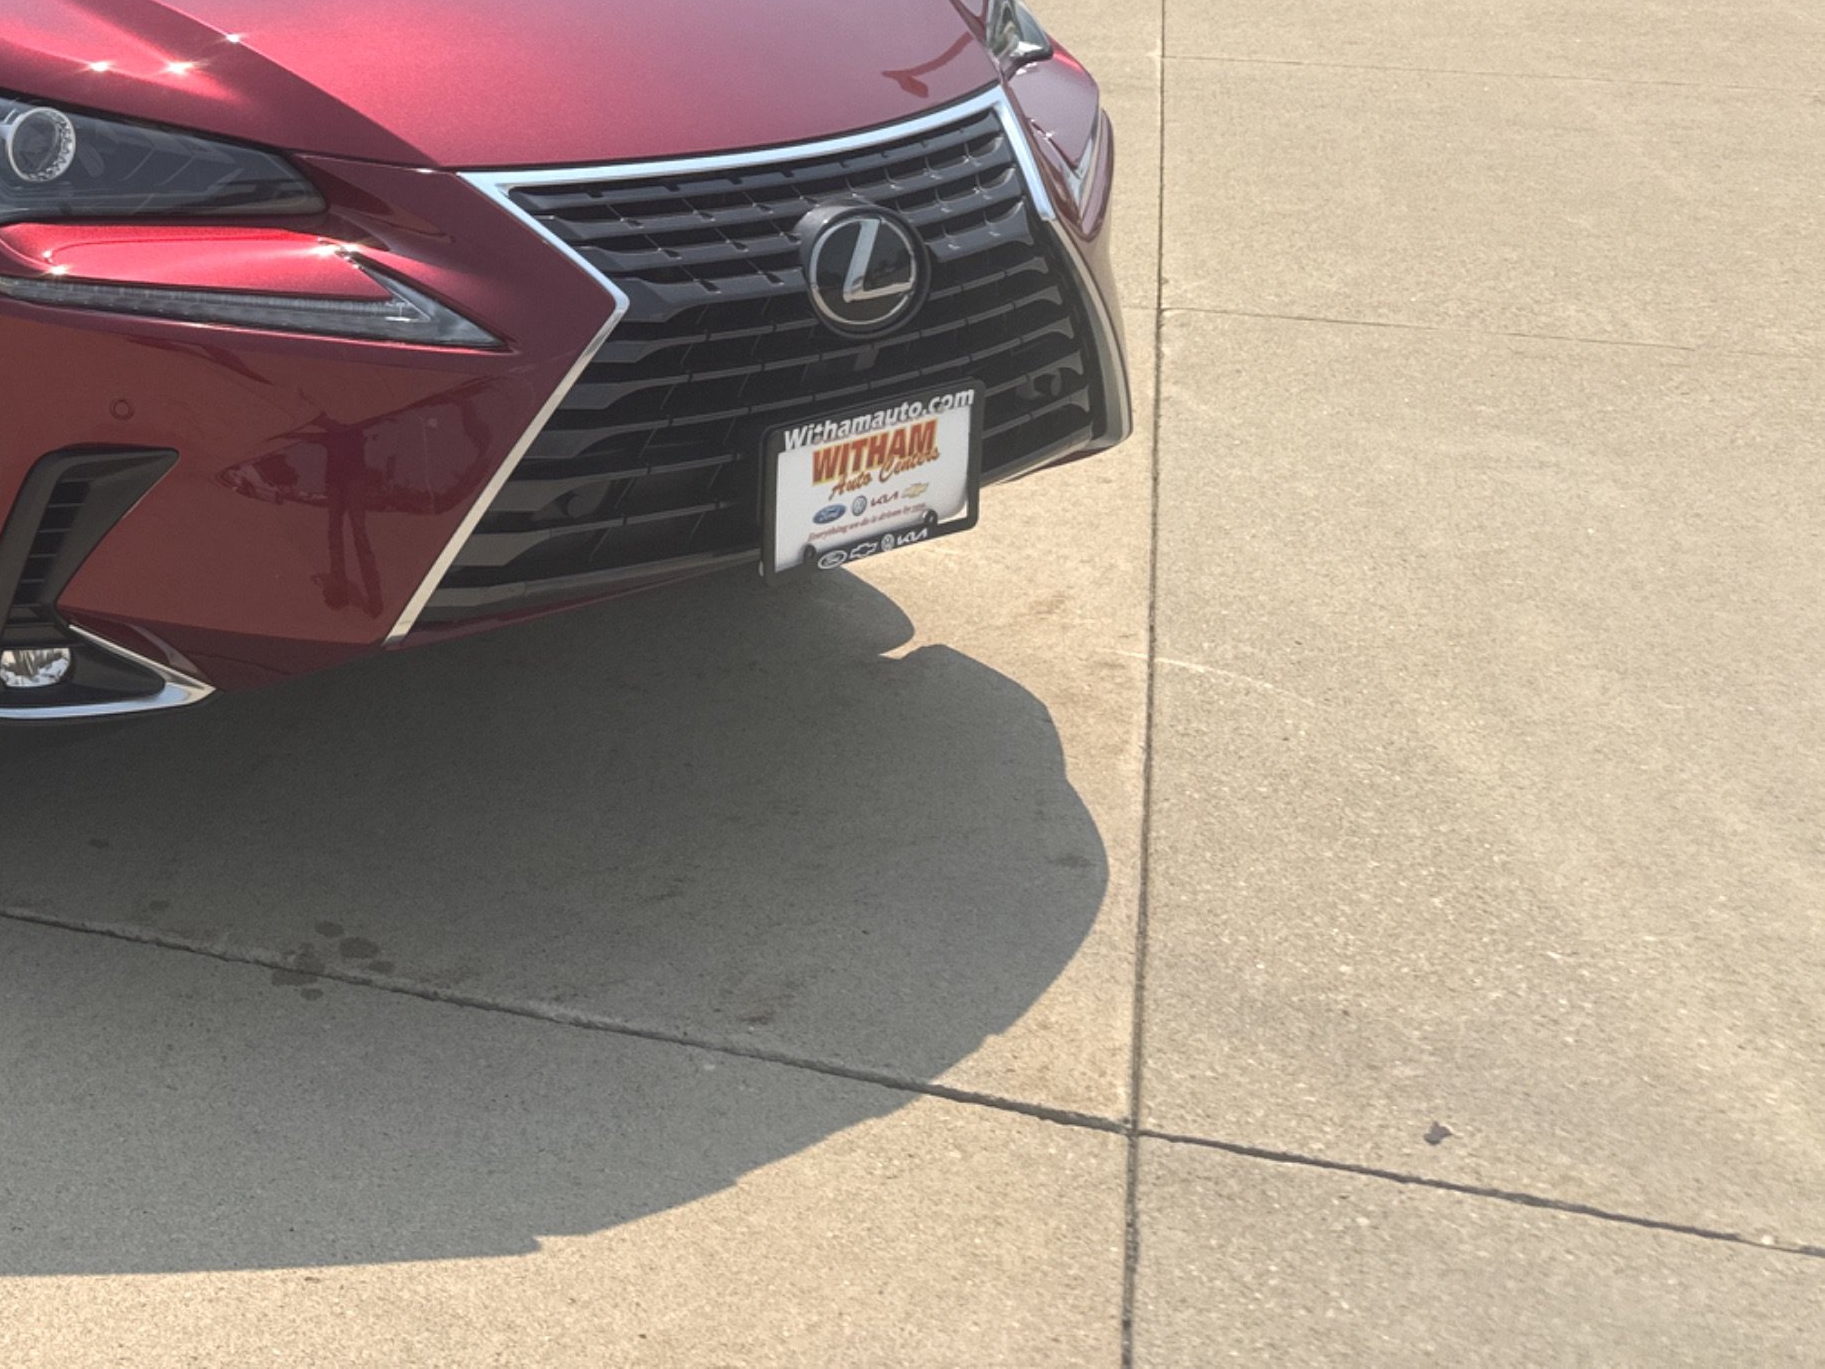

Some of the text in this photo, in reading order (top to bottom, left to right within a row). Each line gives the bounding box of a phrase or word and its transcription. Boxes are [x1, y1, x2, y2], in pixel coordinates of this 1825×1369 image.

[784, 388, 975, 452] Withamauto.com
[812, 418, 938, 486] WITHAM
[828, 446, 940, 501] Auto Centers
